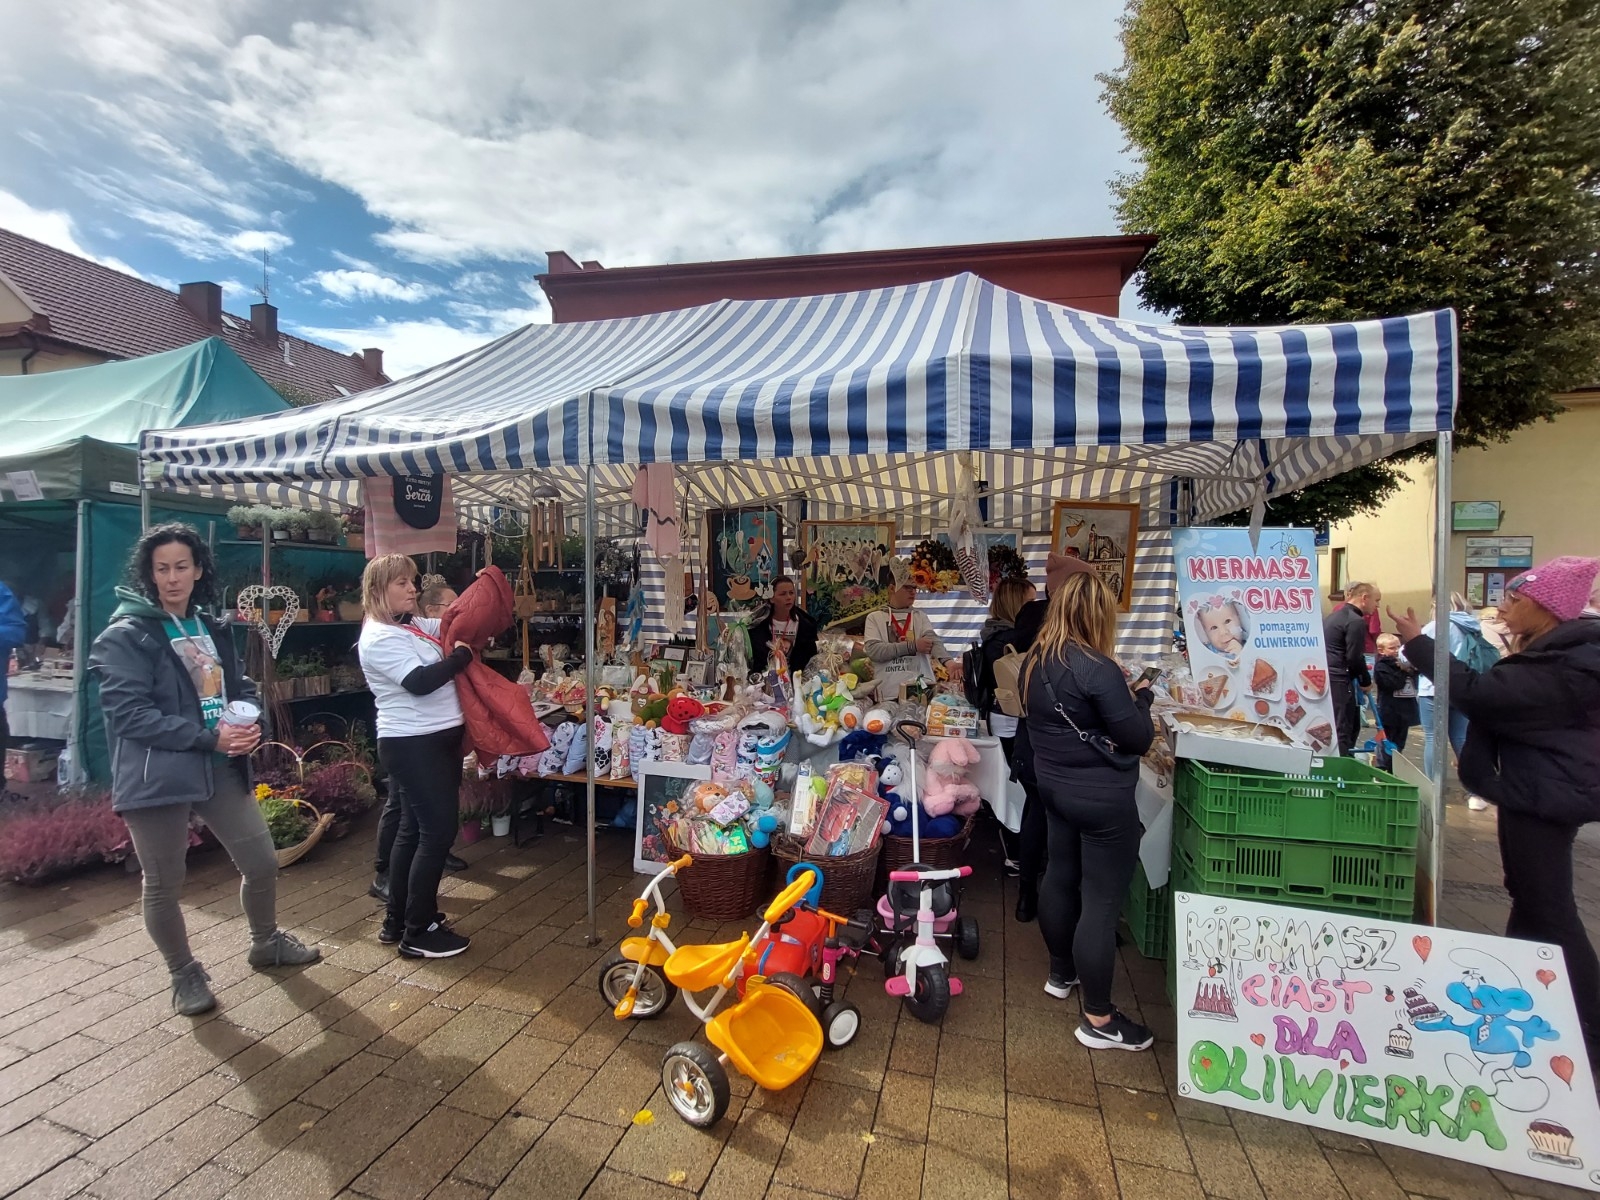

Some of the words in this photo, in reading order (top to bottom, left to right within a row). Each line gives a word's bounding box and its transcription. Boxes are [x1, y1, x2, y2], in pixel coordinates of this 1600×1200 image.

[1188, 557, 1313, 581] KIERMASZ
[1244, 588, 1315, 612] CIAST
[1254, 637, 1319, 648] OLIWIERKOWI
[1260, 622, 1310, 633] pomagamy
[1186, 905, 1400, 974] KIERMASZ
[1242, 973, 1373, 1015] CIAST
[1273, 1015, 1368, 1065] DLA
[1188, 1040, 1508, 1152] OLIWIERKA
